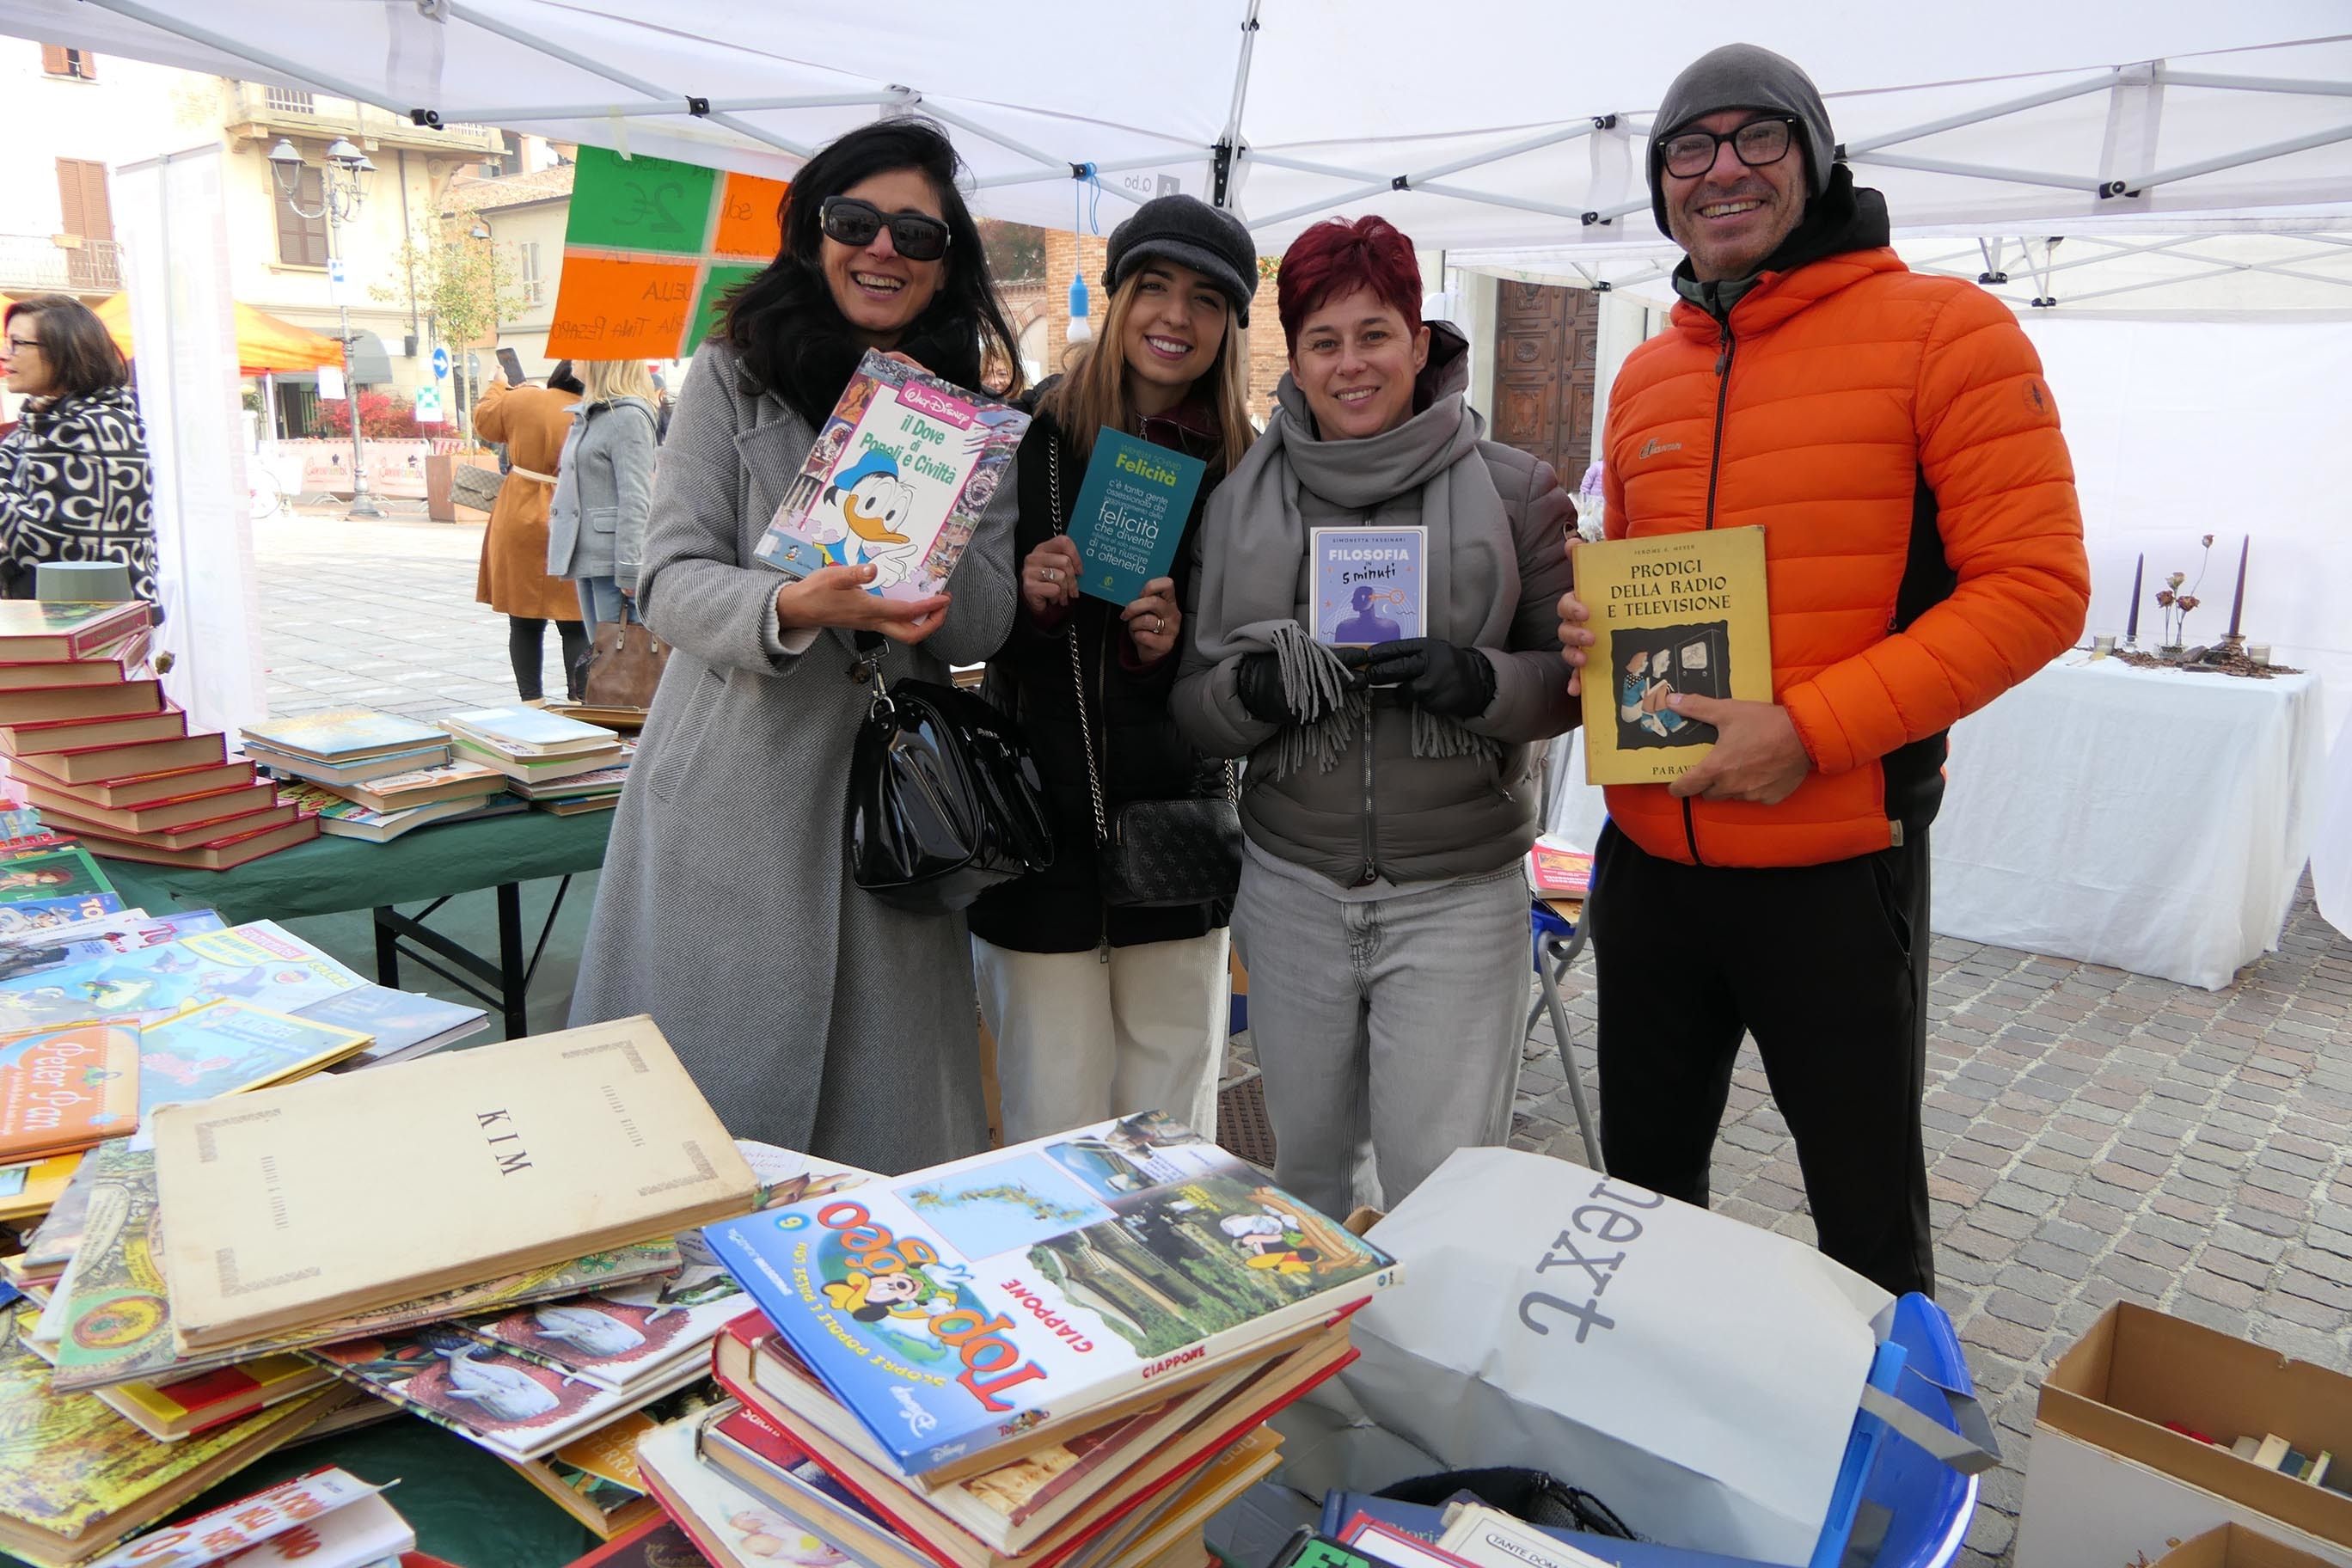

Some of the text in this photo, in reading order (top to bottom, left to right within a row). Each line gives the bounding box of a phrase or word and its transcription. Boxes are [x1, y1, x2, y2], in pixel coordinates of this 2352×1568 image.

[900, 413, 946, 446] il Dove
[859, 432, 958, 487] Popoli e Civiltà
[910, 439, 922, 452] di
[1115, 452, 1178, 487] Felicità
[1124, 483, 1144, 498] tanta
[1146, 493, 1169, 505] gente
[1098, 500, 1160, 540] felicità
[1093, 521, 1155, 549] che diventa
[1086, 548, 1146, 575] a ottenerla
[1088, 537, 1148, 565] di non riuscire
[1328, 548, 1410, 561] FILOSOFIA
[1342, 562, 1396, 585] 5 minuti
[1630, 559, 1702, 579] PRODIGI
[1610, 576, 1727, 600] DELLA RADIO
[1608, 595, 1731, 619] E TELEVISIONE
[1652, 764, 1696, 775] PARAV
[22, 1042, 97, 1131] Peter Pan
[476, 1107, 534, 1178] KIM
[1000, 1277, 1095, 1354] GIAPPONE
[818, 1313, 871, 1357] POPOLI
[869, 1355, 946, 1387] SCOPRI
[1142, 1344, 1207, 1379] GIAPPONE
[889, 1385, 939, 1439] Disney
[1491, 1533, 1528, 1557] TANTE
